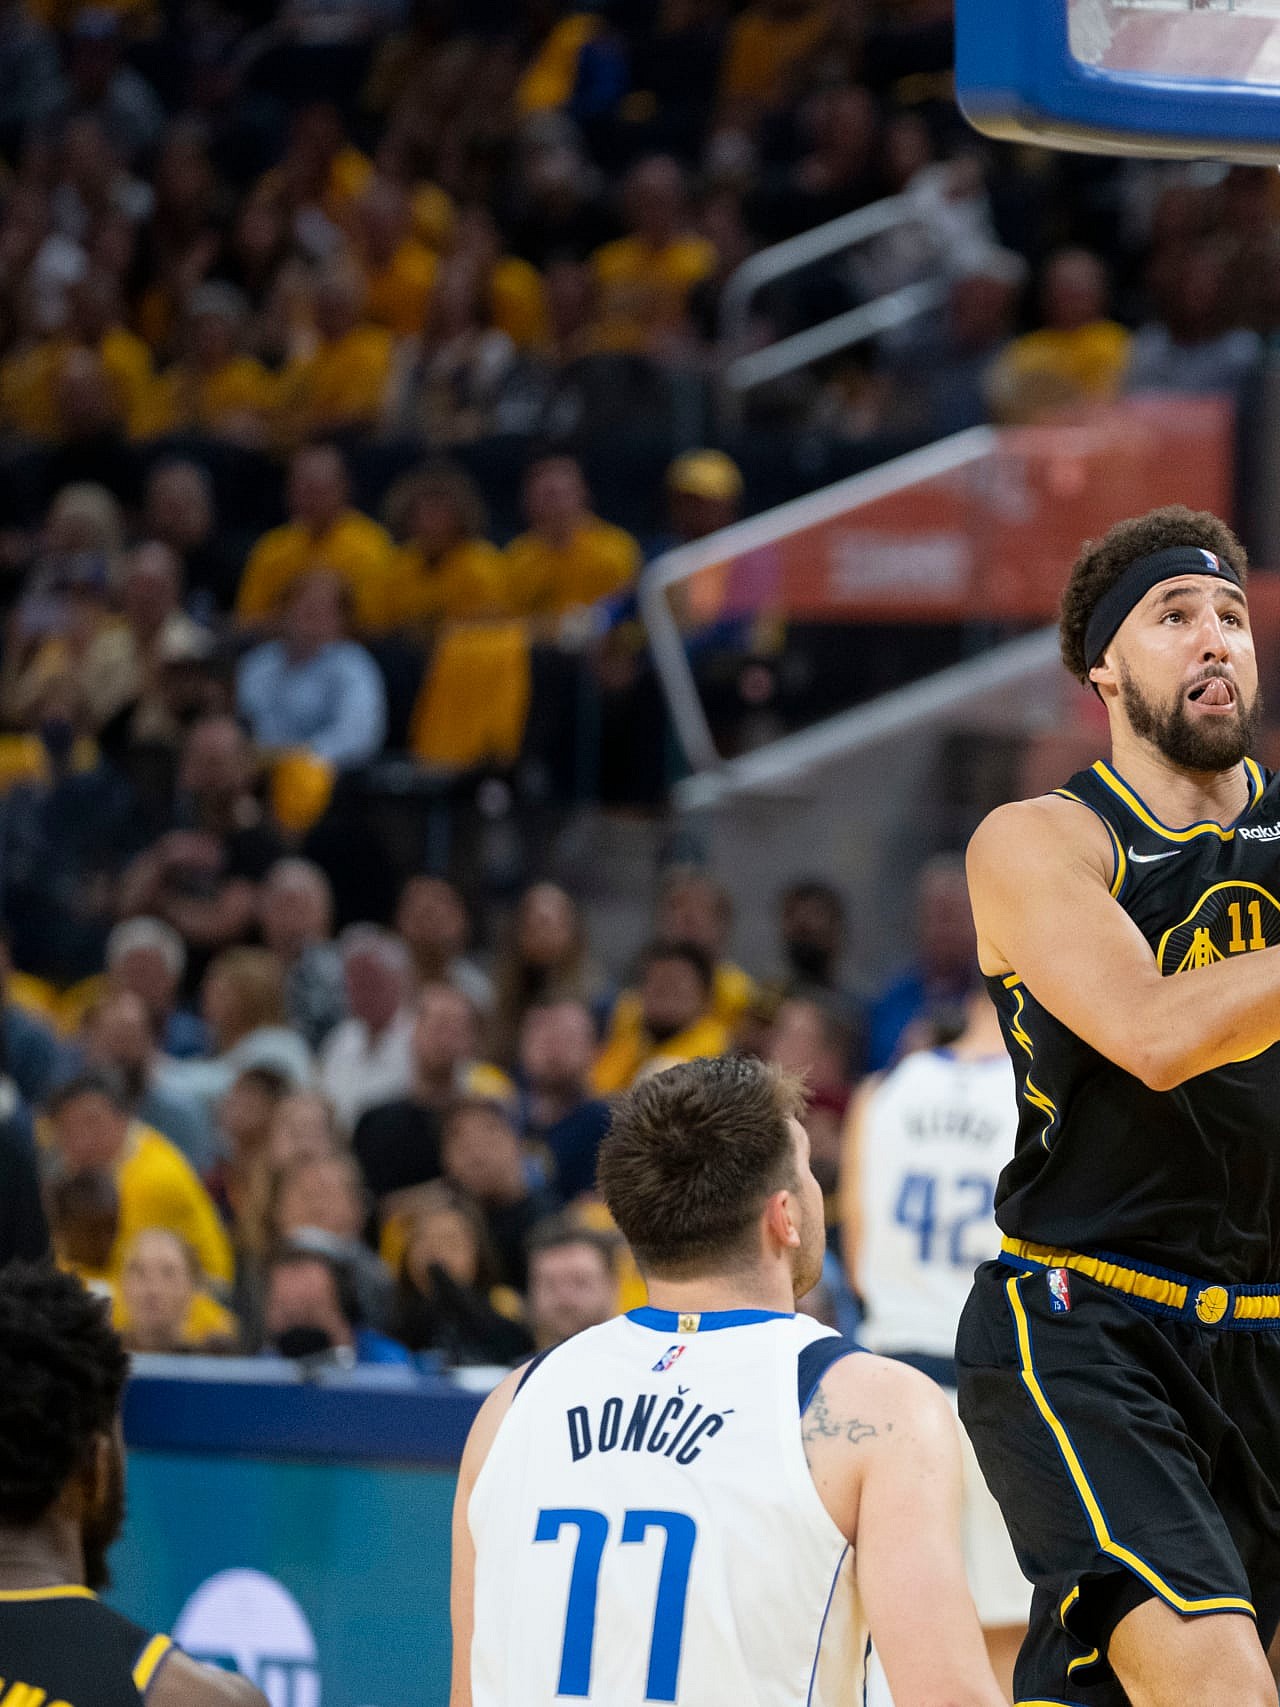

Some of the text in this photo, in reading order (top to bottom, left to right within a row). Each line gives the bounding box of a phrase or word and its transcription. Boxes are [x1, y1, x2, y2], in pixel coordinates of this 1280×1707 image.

[1228, 900, 1266, 952] 11
[894, 1174, 996, 1266] 42
[566, 1385, 735, 1466] DONČIĆ
[531, 1506, 699, 1705] 77
